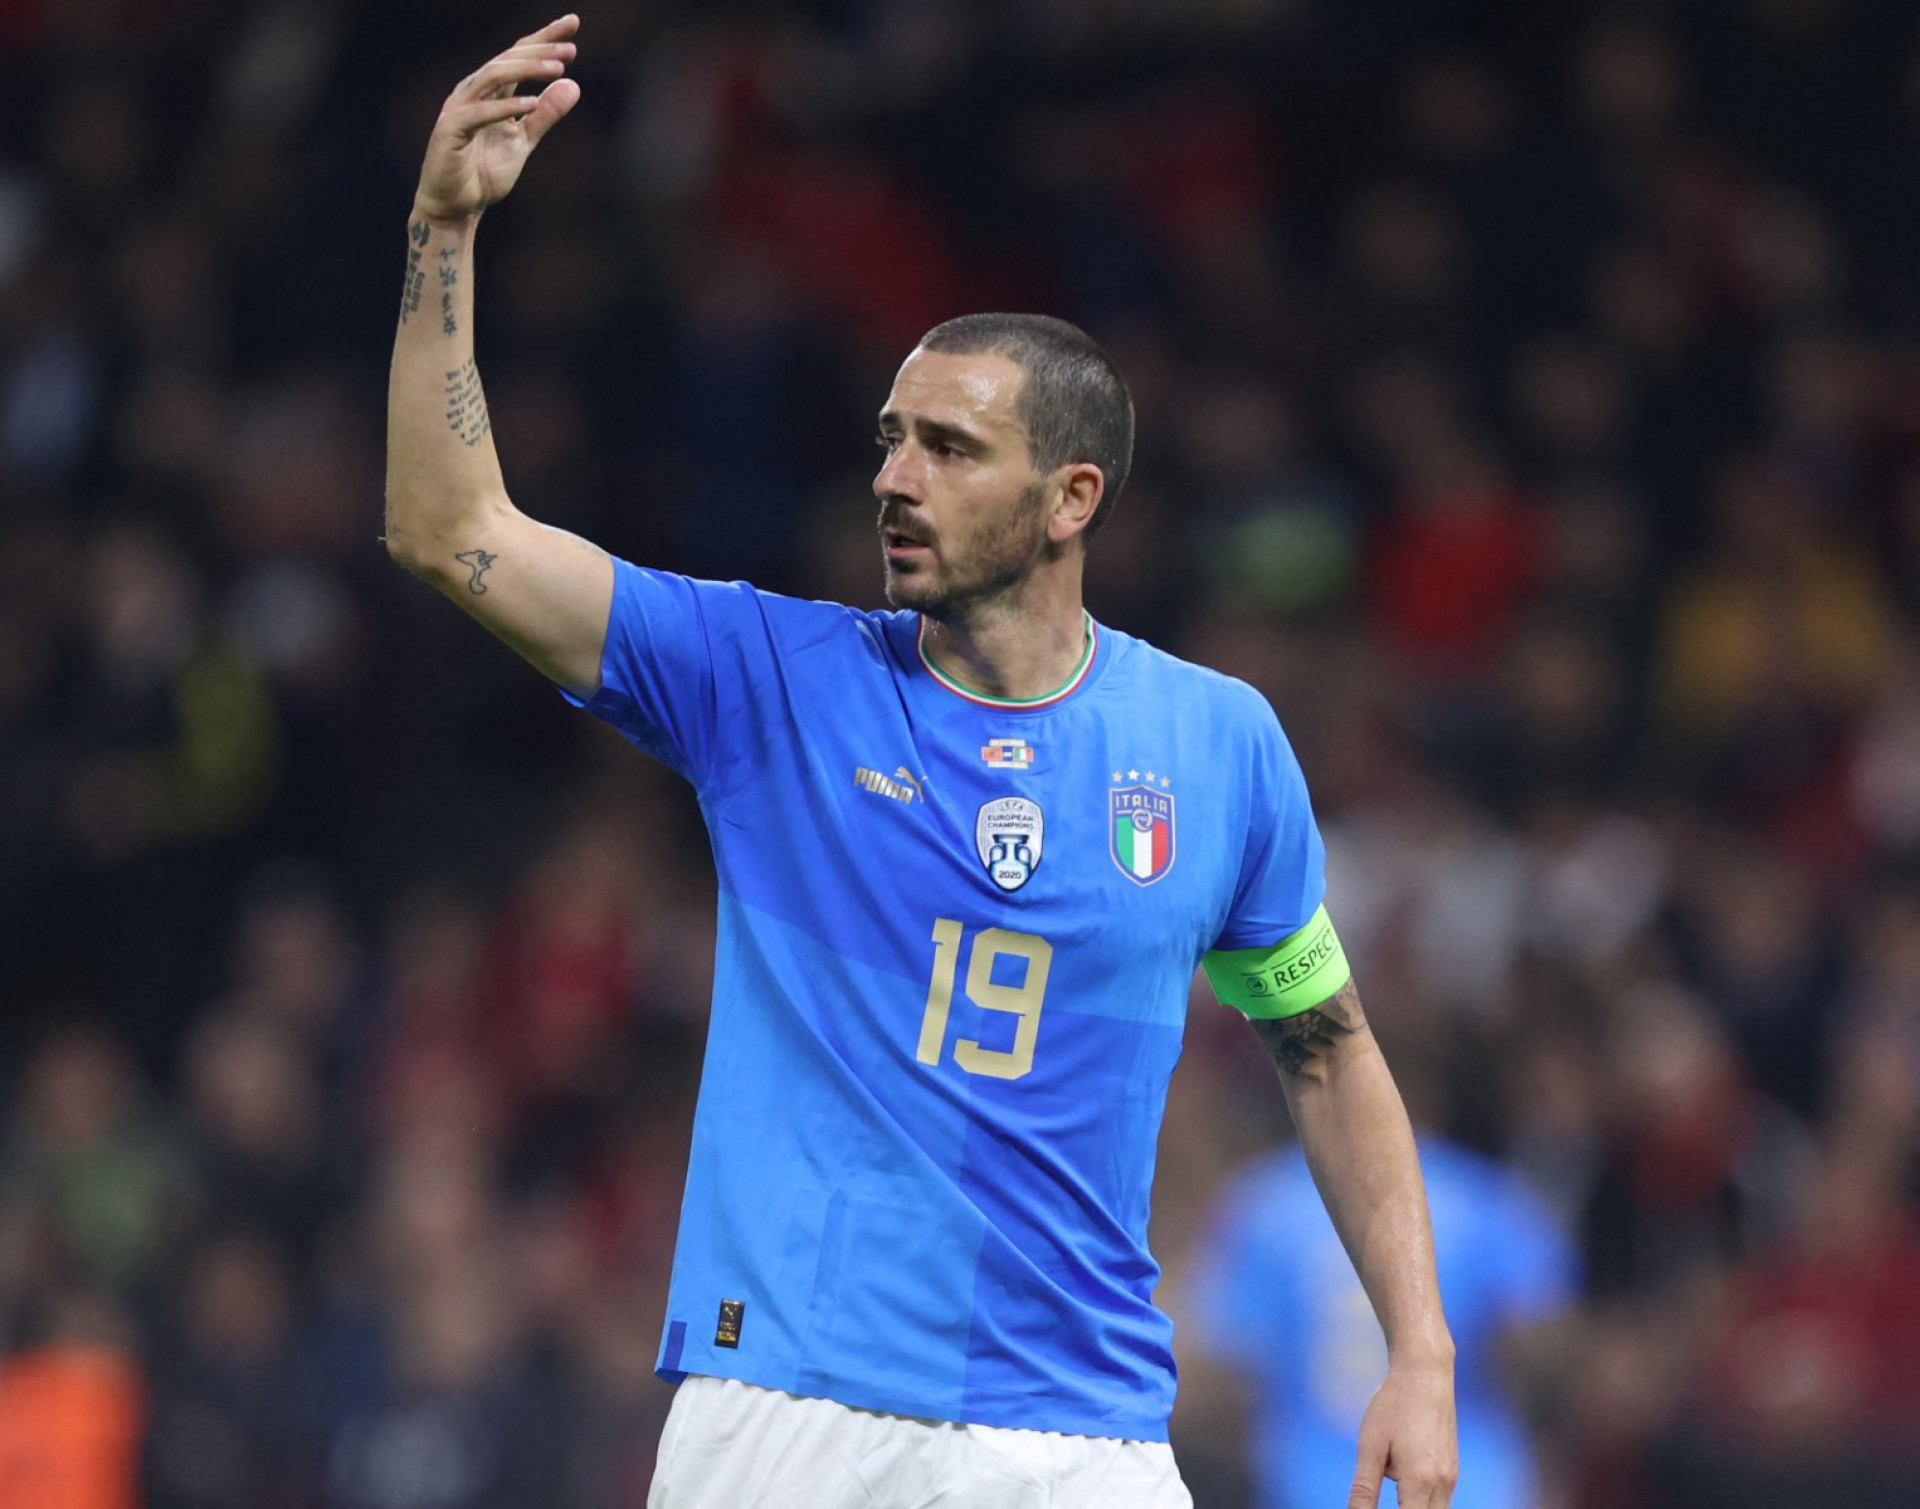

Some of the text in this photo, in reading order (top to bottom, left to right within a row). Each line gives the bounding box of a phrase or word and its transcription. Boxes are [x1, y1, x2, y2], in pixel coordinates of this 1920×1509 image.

[854, 767, 914, 805] PUMA
[1115, 794, 1168, 813] ITALIA
[988, 814, 1034, 822] EUROPEAN
[988, 822, 1034, 830] CHAMPIONS
[998, 871, 1022, 879] 2020
[916, 917, 1054, 1080] 19
